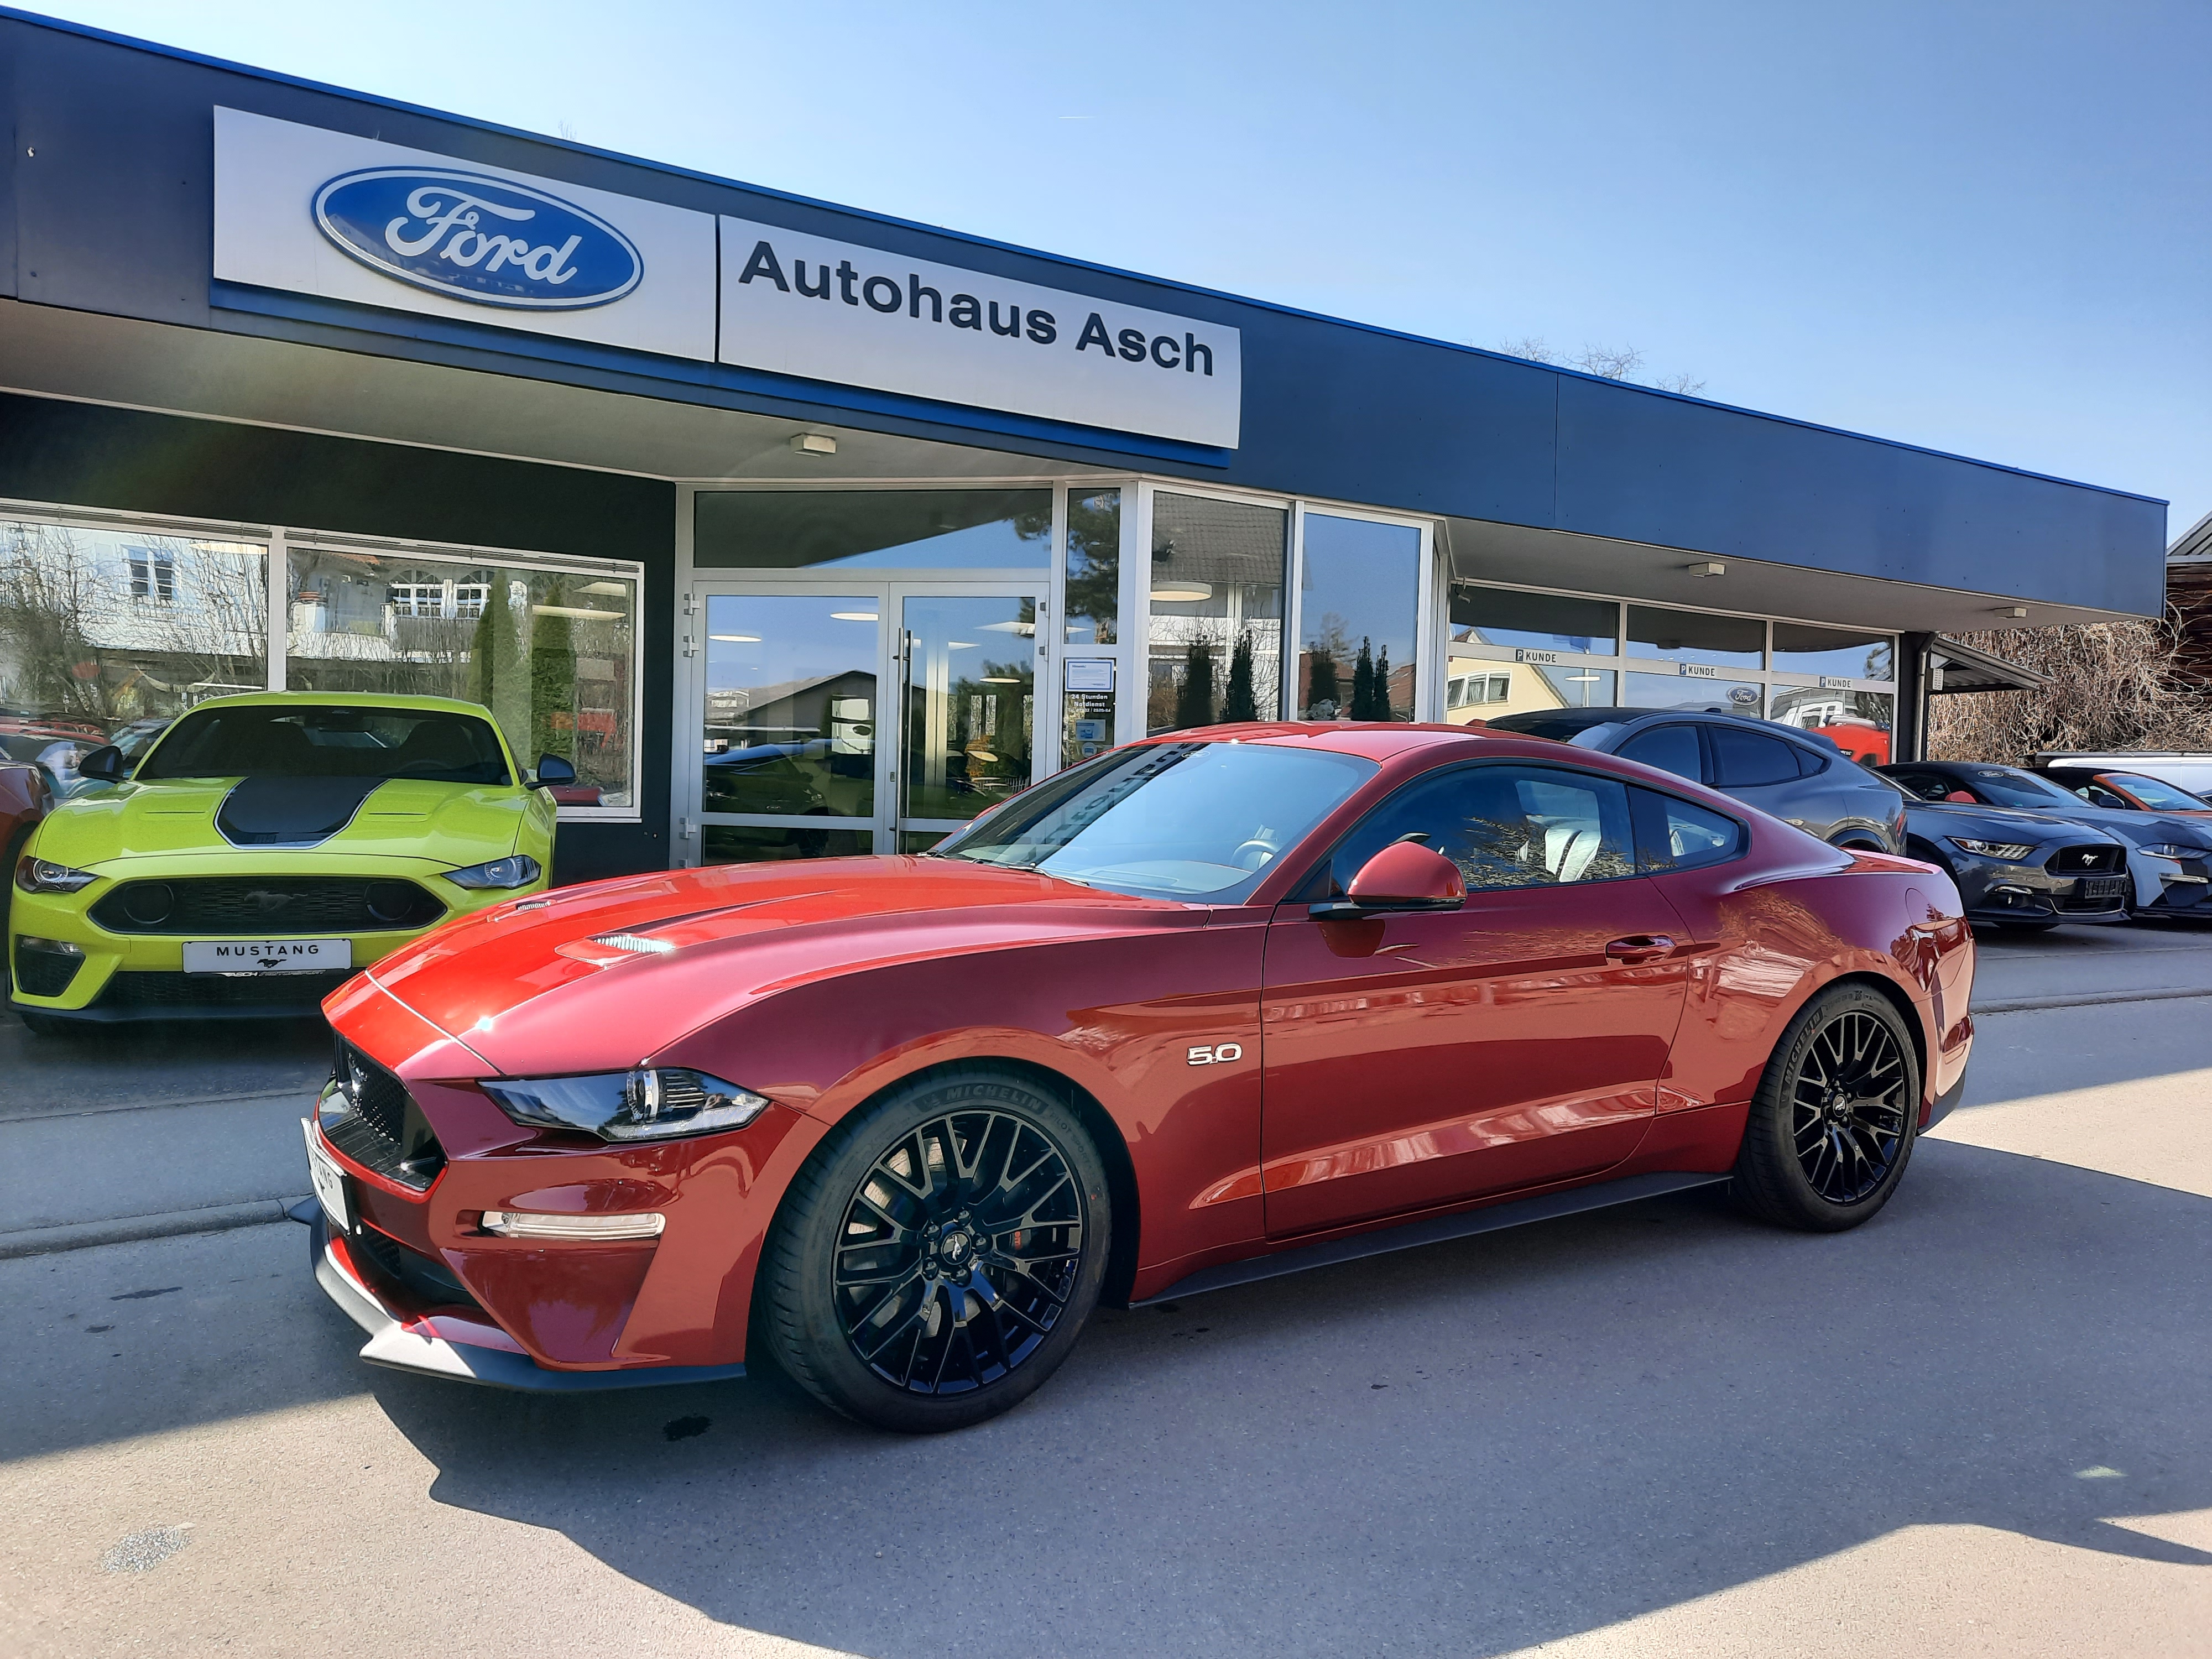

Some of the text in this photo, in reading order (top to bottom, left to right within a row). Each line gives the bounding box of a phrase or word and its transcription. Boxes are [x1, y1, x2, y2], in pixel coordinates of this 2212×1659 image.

[384, 186, 578, 285] Ford
[738, 240, 1213, 377] Autohaus Asch
[1526, 651, 1556, 662] KUNDE
[1688, 666, 1715, 676] KUNDE
[1828, 678, 1851, 688] KUNDE
[1734, 689, 1753, 702] Ford
[216, 945, 319, 956] MUSTANG
[1785, 1012, 1820, 1085] MICHELIN
[946, 1084, 1042, 1110] MICHELIN
[1050, 1109, 1072, 1133] PILOT
